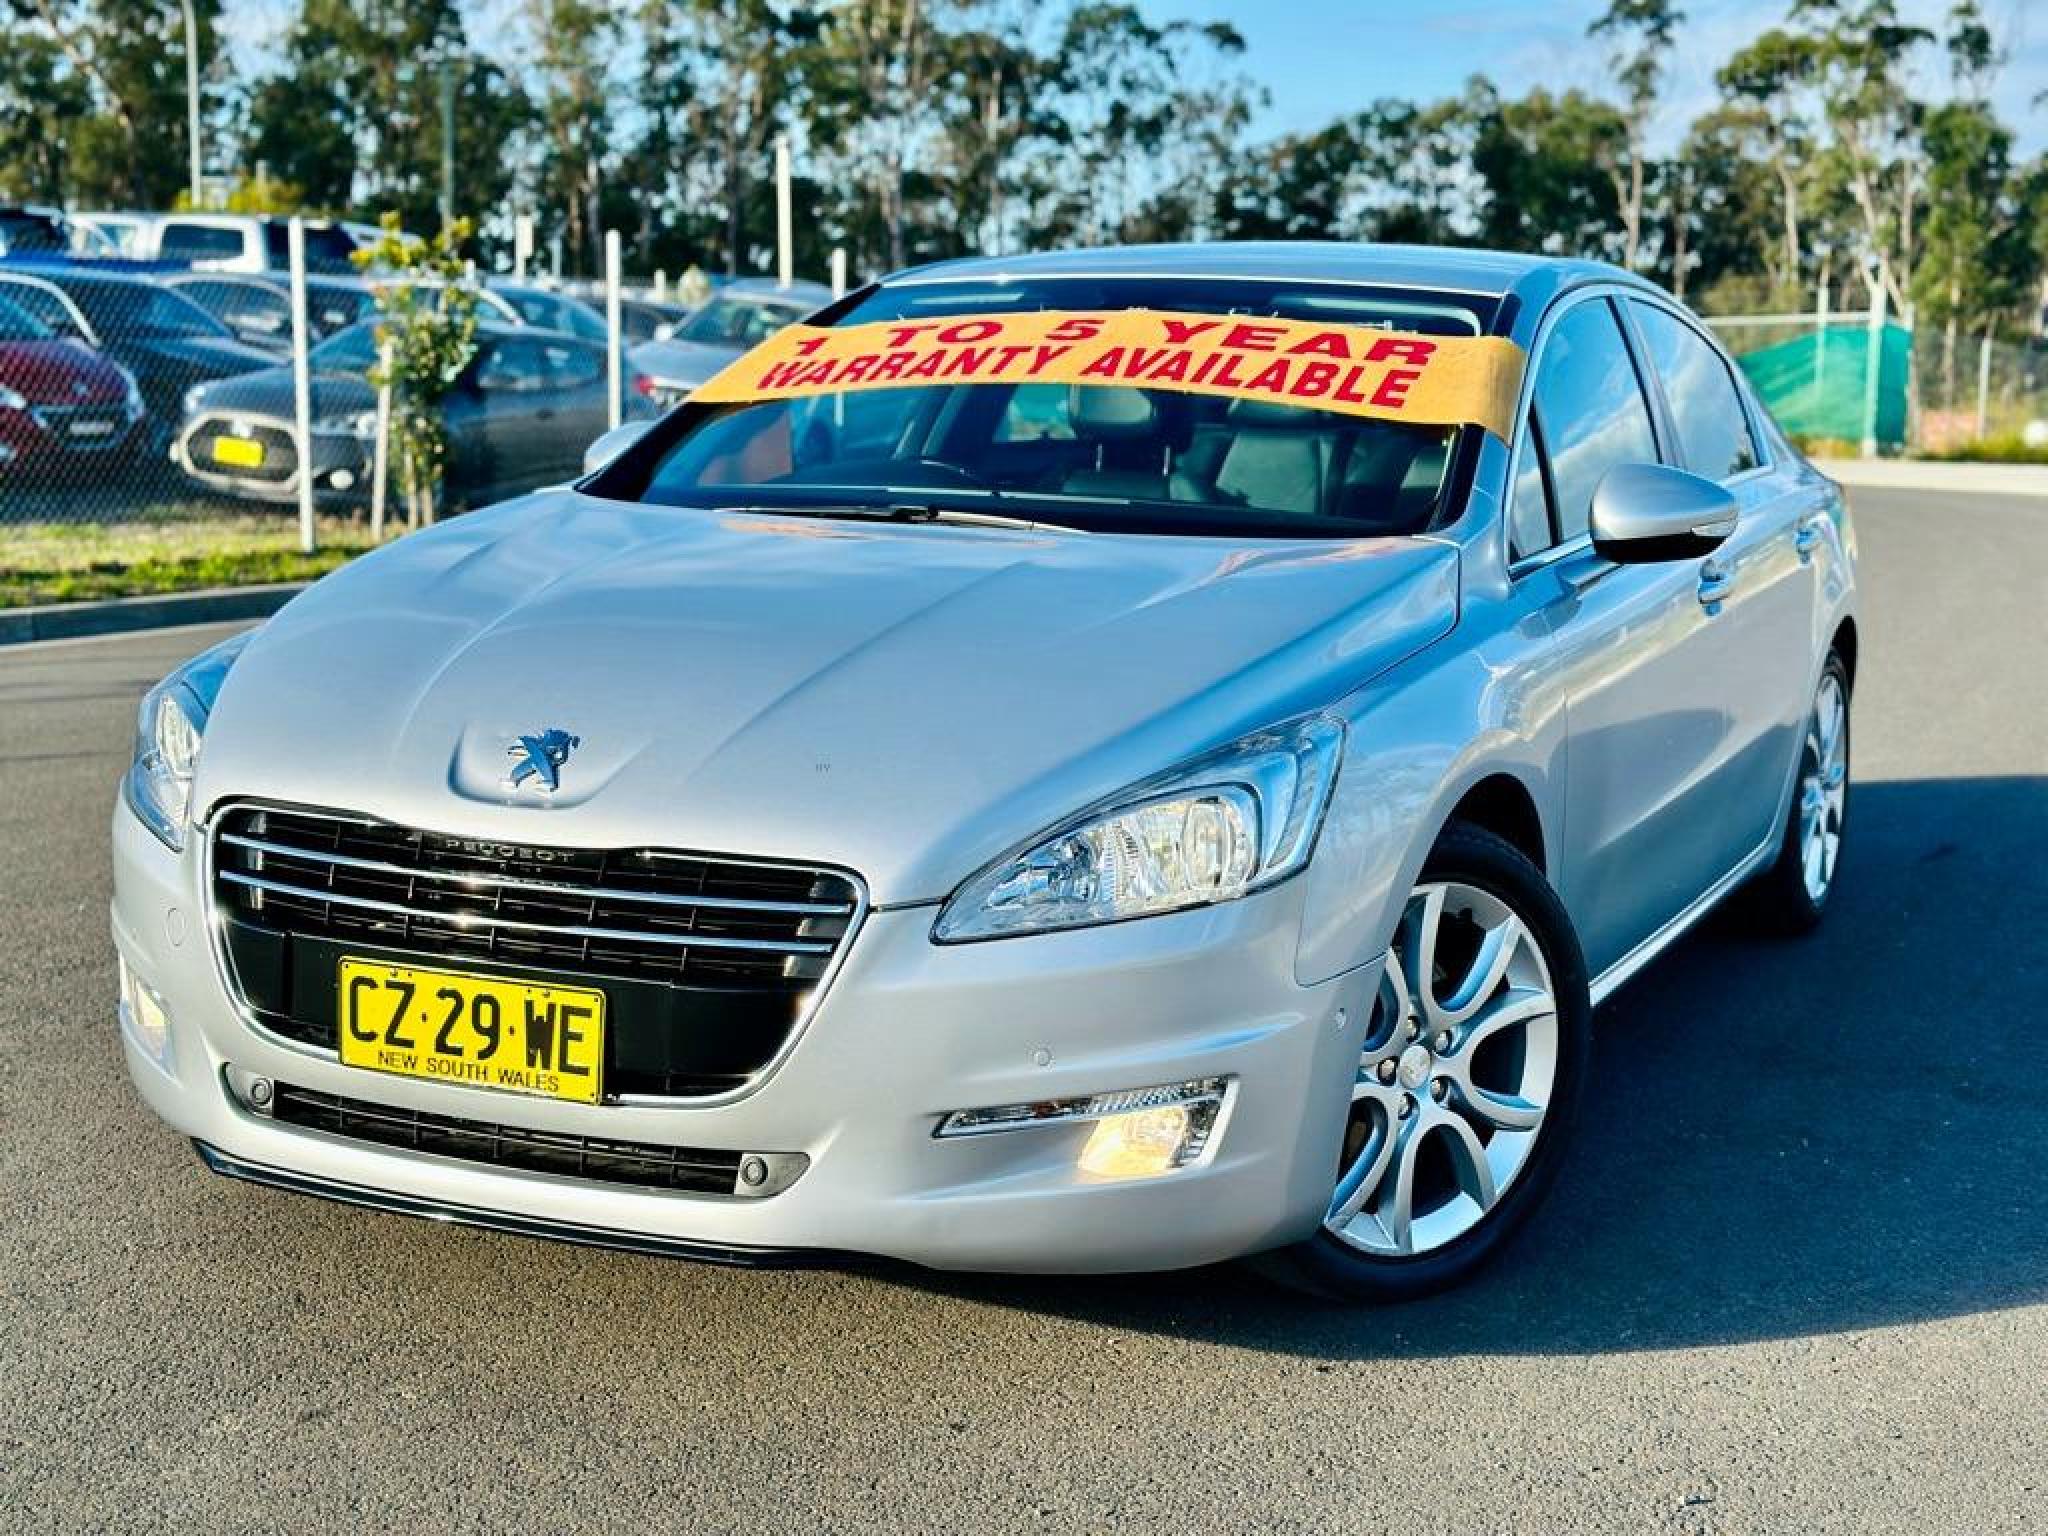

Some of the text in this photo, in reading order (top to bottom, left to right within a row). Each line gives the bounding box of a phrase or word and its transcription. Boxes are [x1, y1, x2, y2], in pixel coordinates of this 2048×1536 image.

[797, 319, 1438, 366] 1 TO 5 YEAR
[756, 345, 1421, 408] WARRANTY AVAILABLE
[378, 1051, 559, 1092] NEW SOUTH WALES
